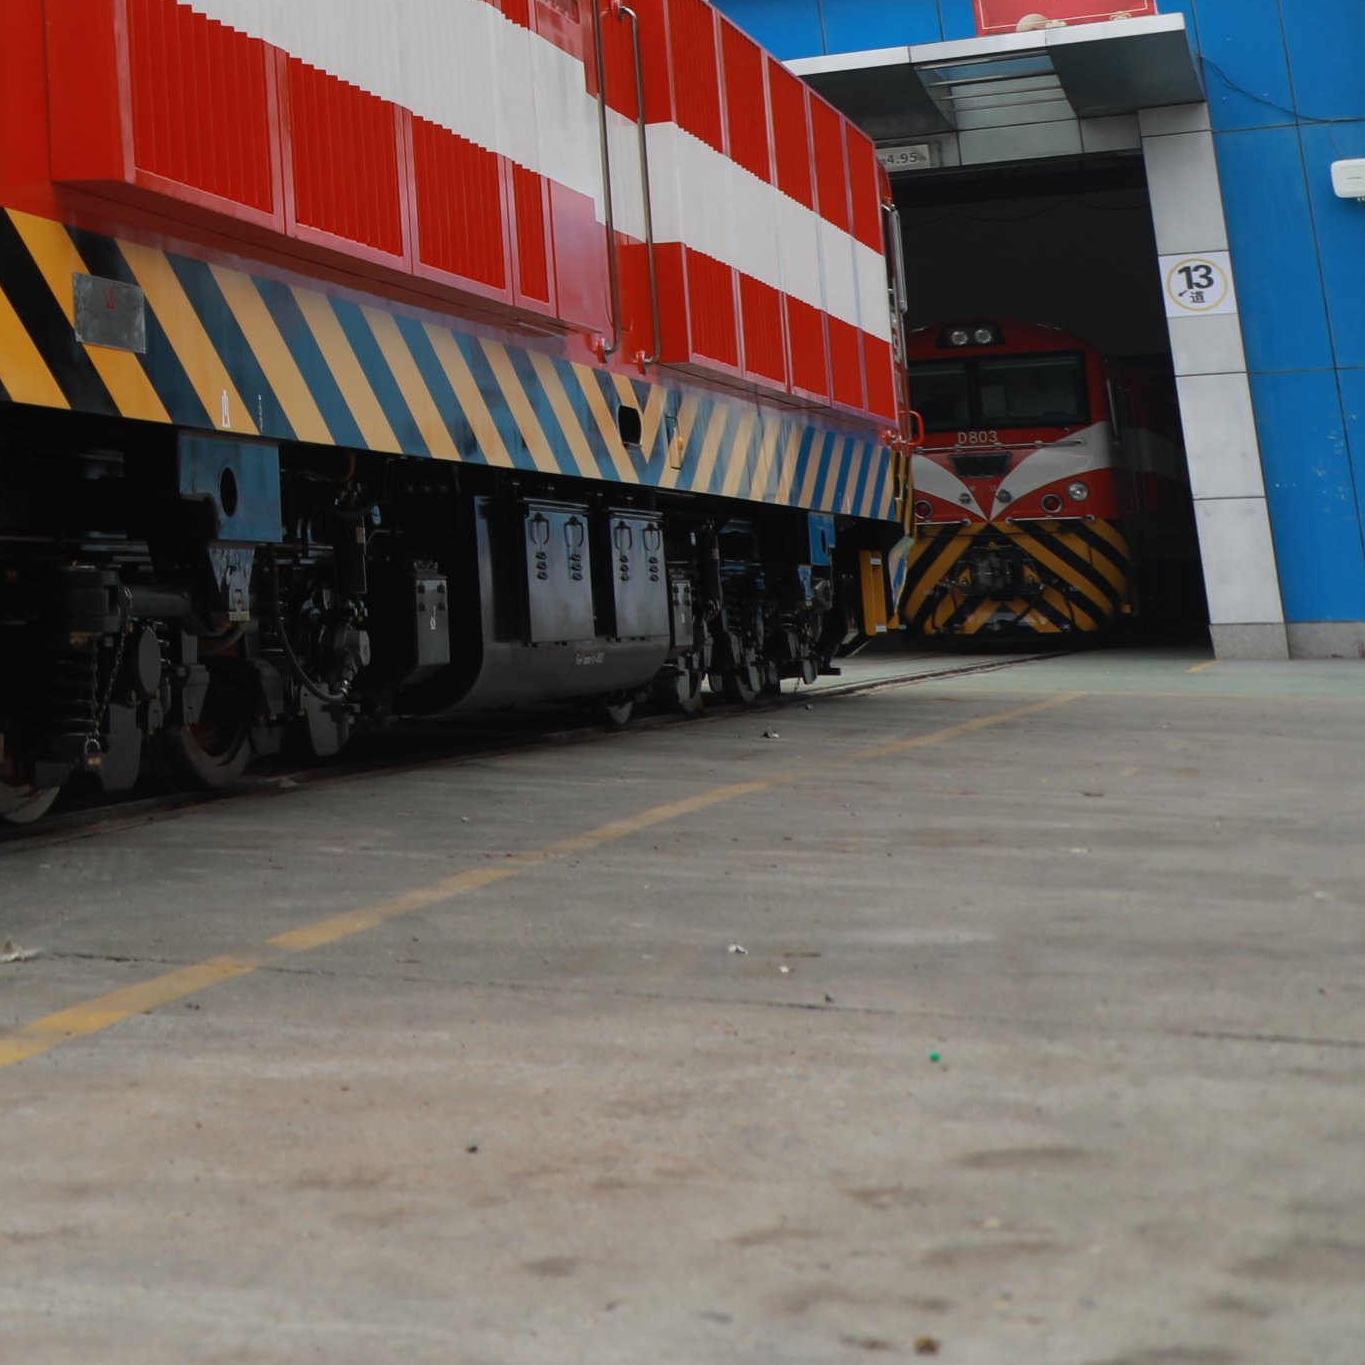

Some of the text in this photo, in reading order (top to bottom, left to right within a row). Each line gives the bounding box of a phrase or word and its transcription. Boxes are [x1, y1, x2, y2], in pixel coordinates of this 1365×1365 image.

[1177, 264, 1214, 290] 13
[1189, 290, 1206, 303] 道
[957, 430, 998, 444] D803
